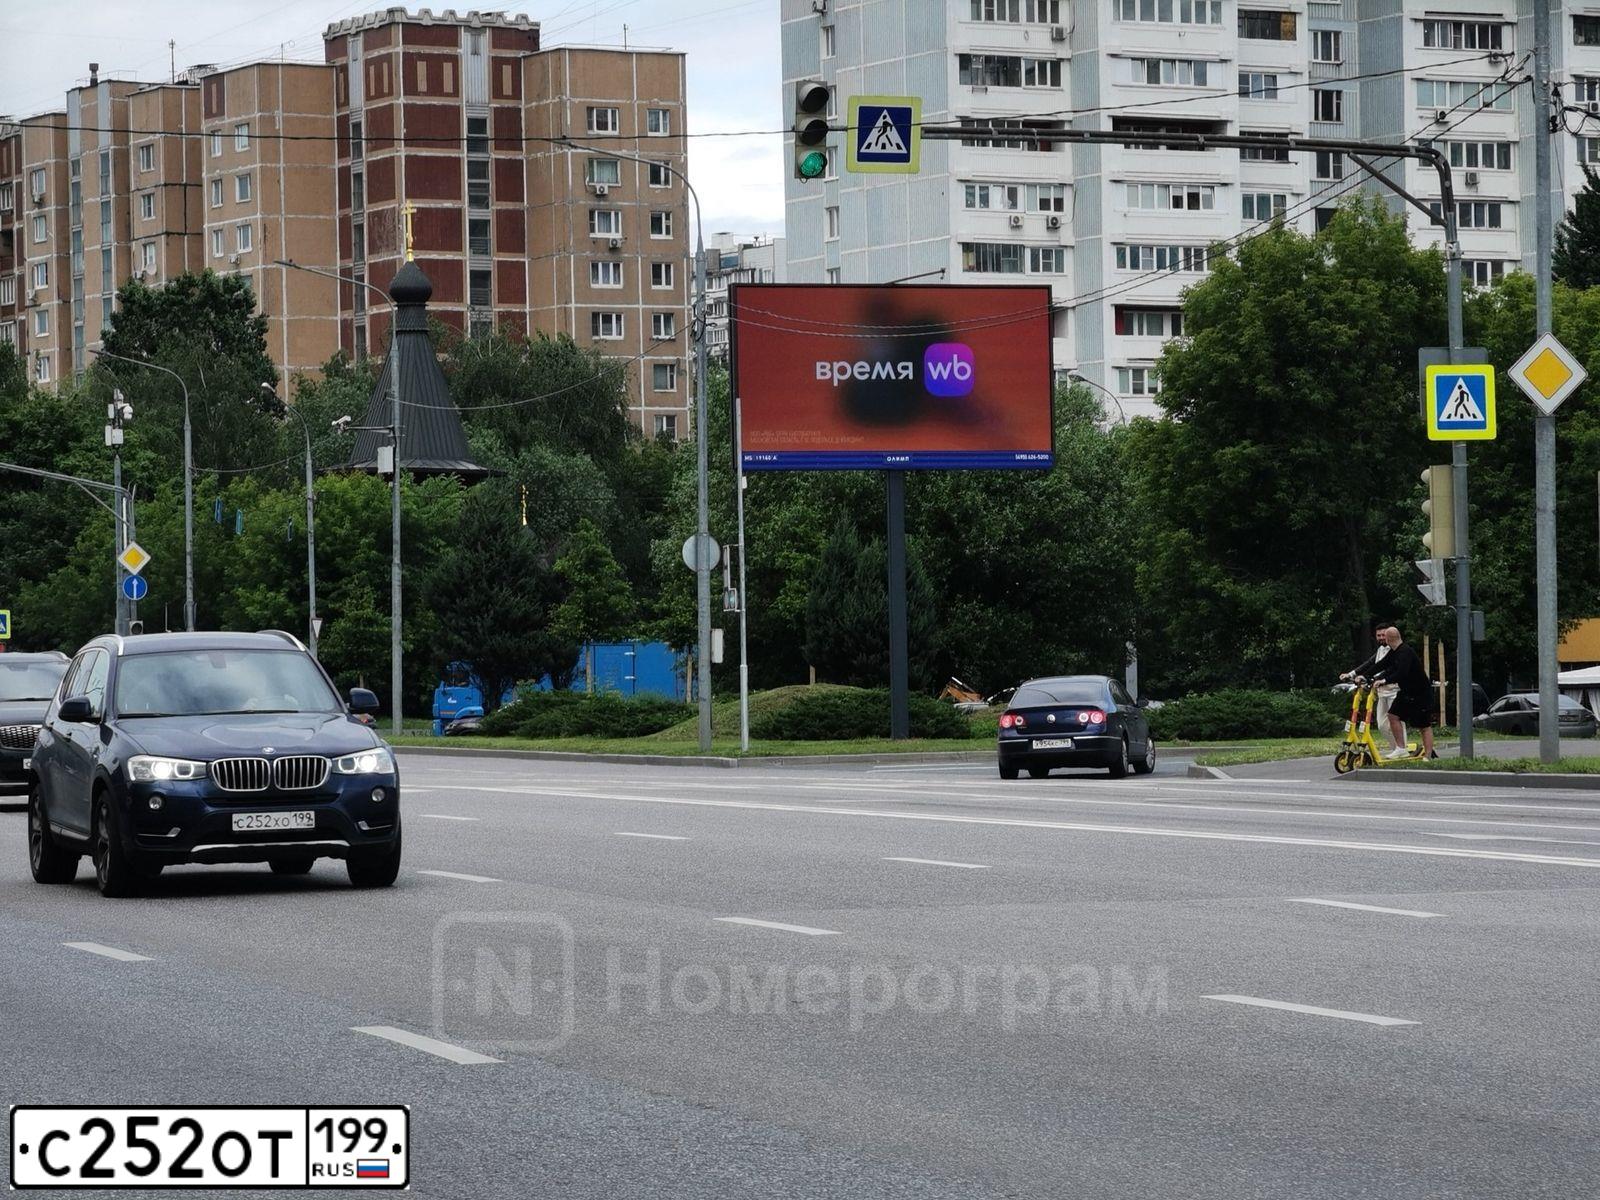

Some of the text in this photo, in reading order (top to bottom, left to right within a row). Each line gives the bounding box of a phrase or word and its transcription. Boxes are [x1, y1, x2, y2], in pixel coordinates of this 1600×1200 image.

[816, 354, 972, 387] время wb
[236, 812, 313, 829] С252ХО 199
